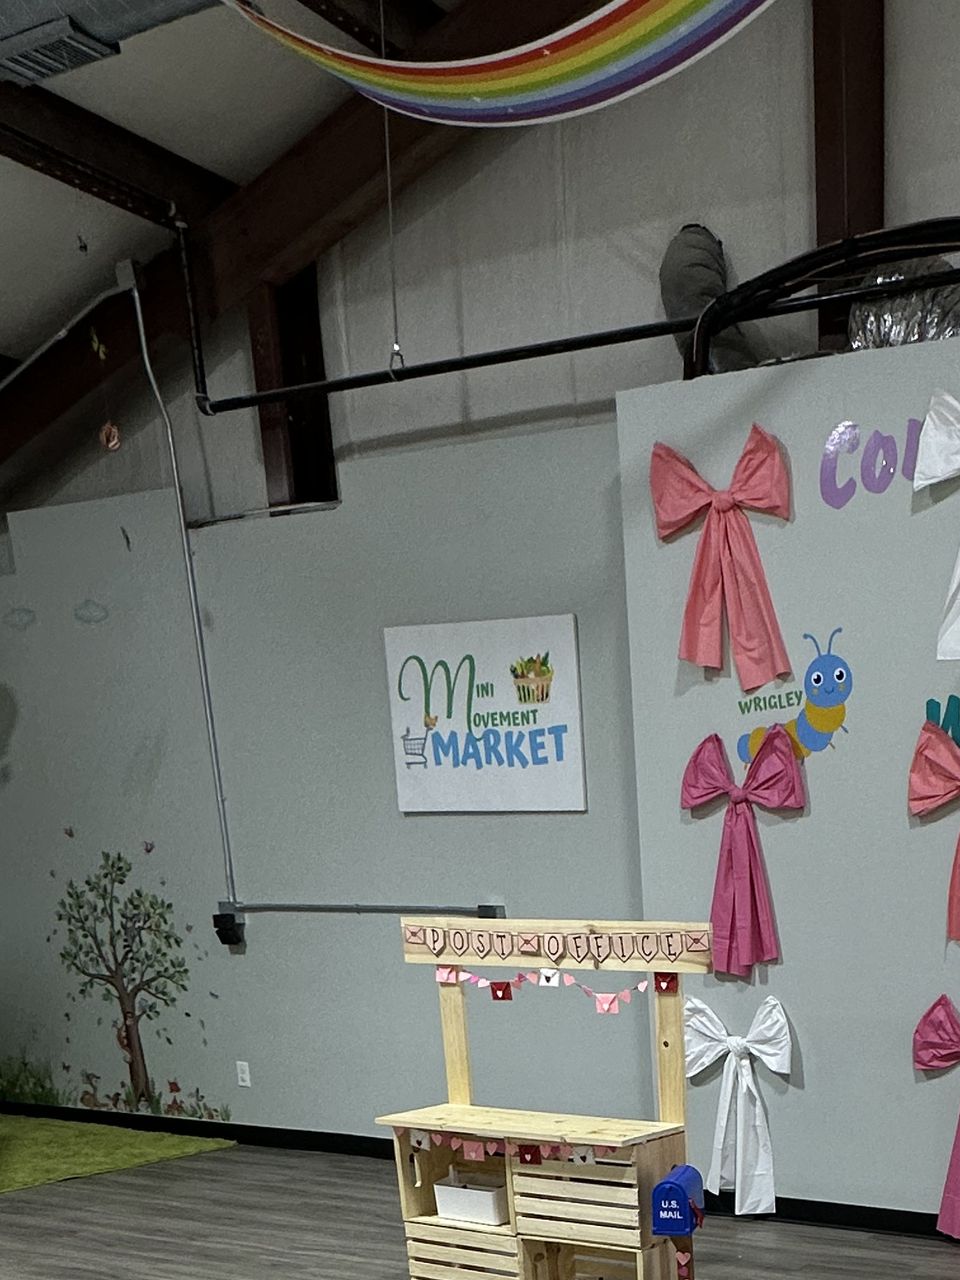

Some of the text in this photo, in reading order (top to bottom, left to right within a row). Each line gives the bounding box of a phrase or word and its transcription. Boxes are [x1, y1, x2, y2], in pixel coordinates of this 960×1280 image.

[737, 689, 804, 716] WRIGLEY
[430, 723, 568, 770] MARKET
[431, 930, 677, 958] POST OFFICE
[659, 1210, 684, 1219] MAIL
[661, 1200, 680, 1209] U.S.
